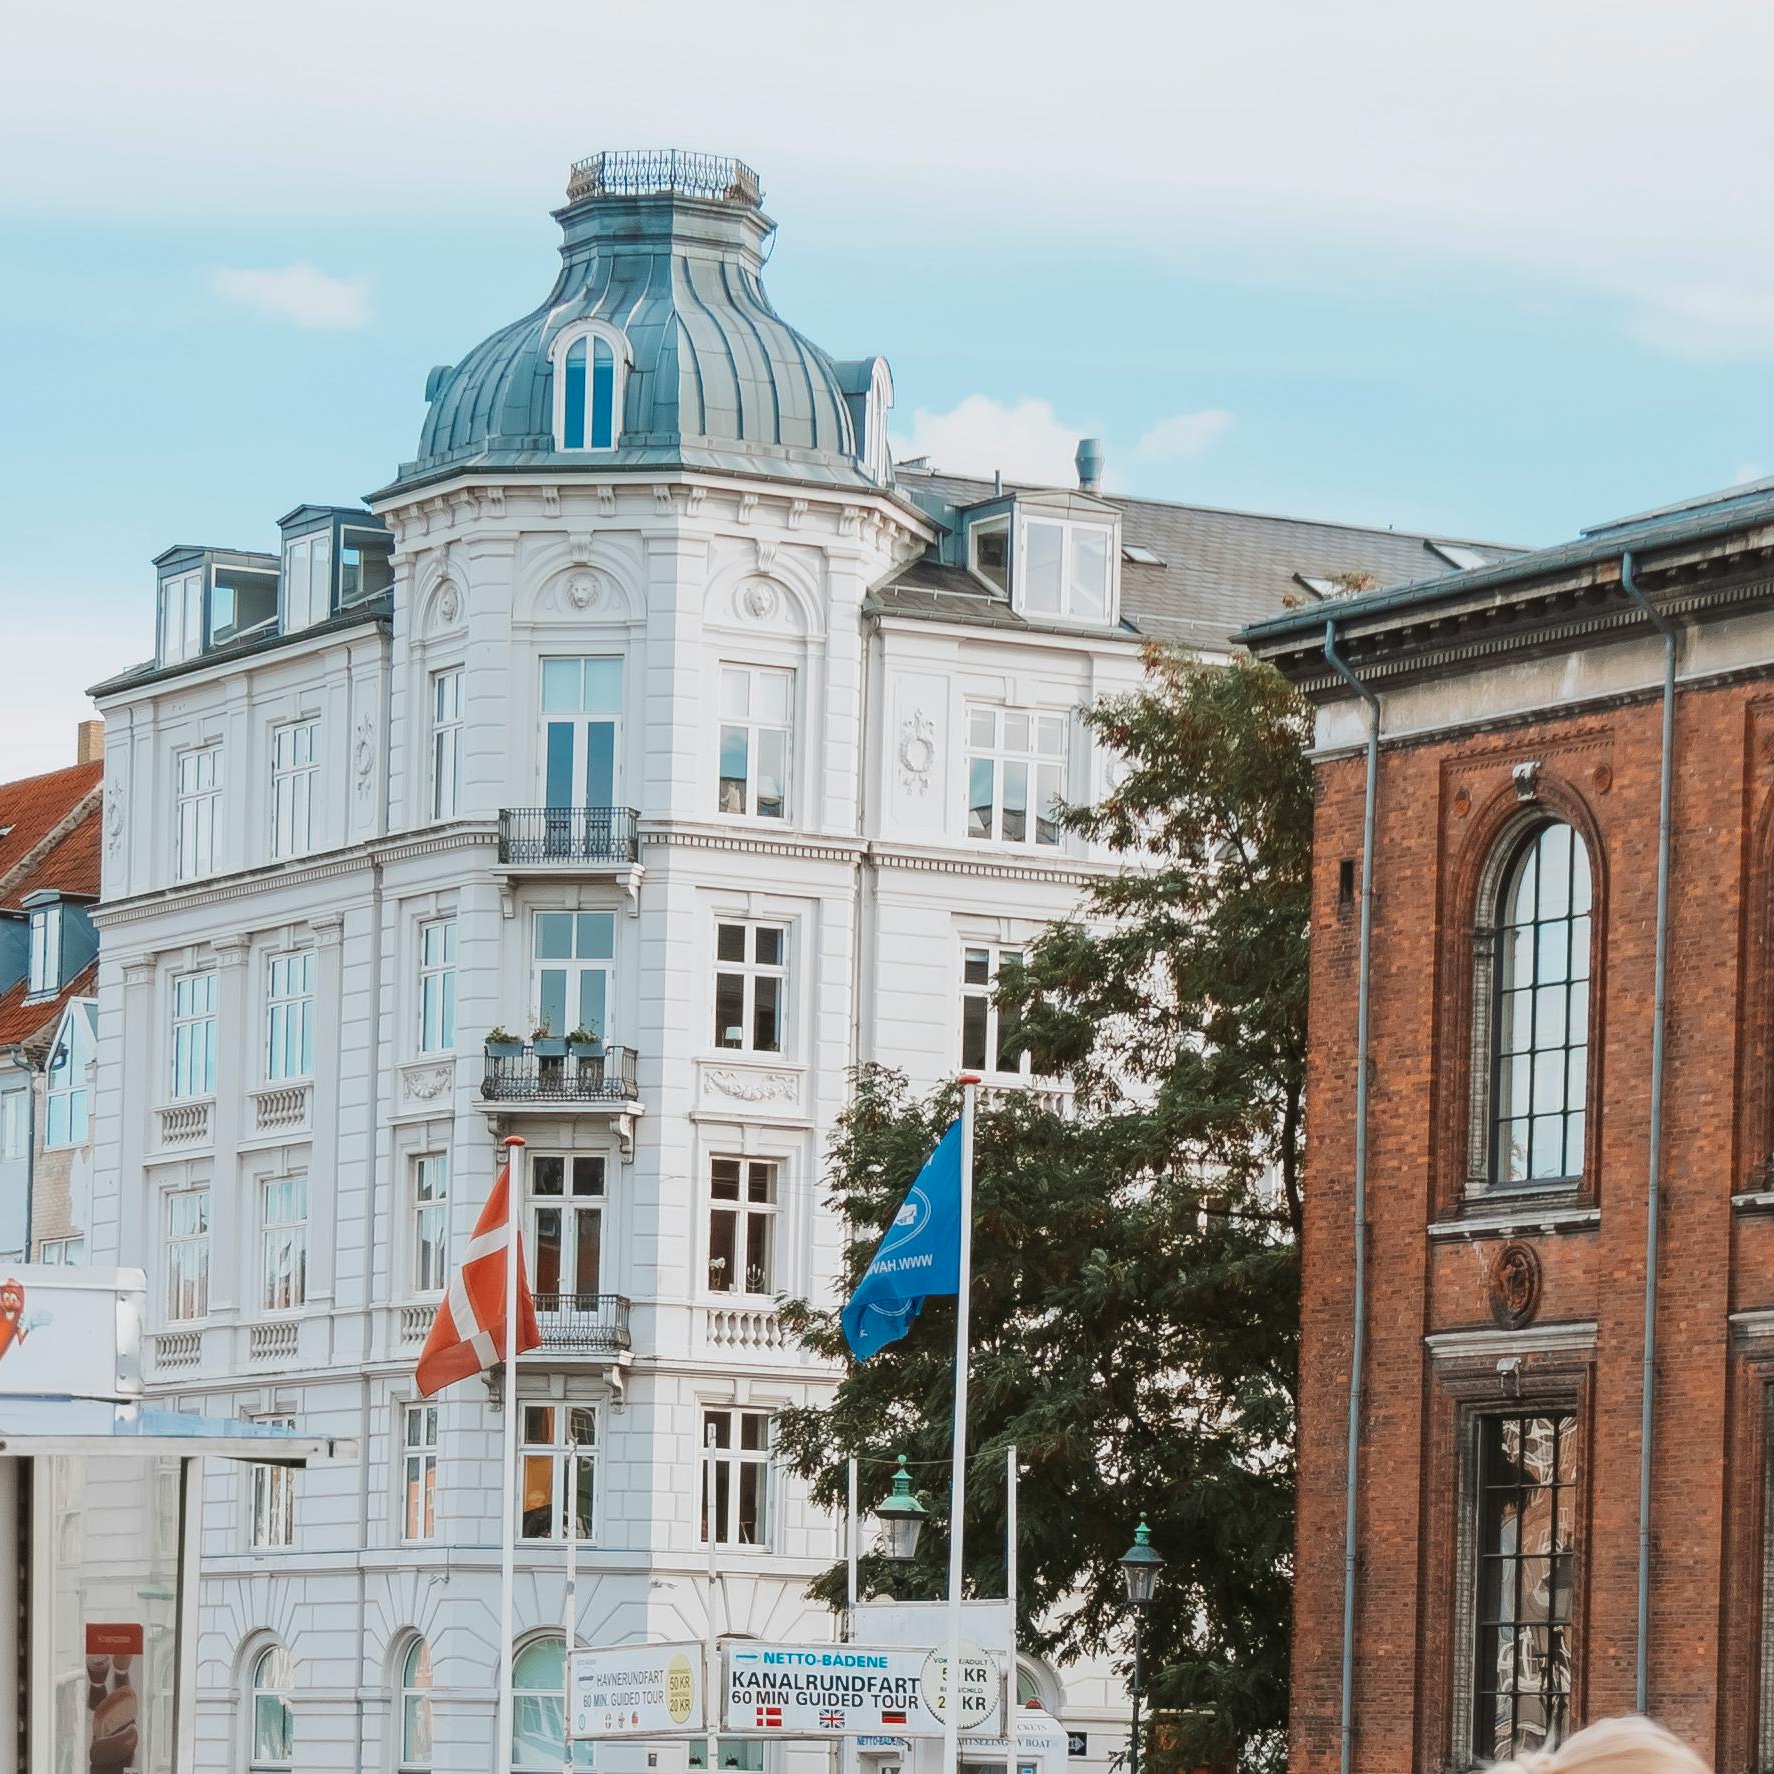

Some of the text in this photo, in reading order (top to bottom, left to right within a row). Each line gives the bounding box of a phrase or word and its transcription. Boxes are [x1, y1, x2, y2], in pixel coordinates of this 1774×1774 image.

[763, 1651, 889, 1669] NETTO-BÅDENE
[596, 1669, 664, 1688] HAVNERUNDFART
[669, 1675, 690, 1690] 50 KR
[731, 1671, 920, 1694] KANALRUNDFART
[964, 1668, 988, 1683] KR
[583, 1694, 592, 1708] 60
[610, 1692, 641, 1706] GUIDED
[643, 1690, 664, 1704] TOUR
[669, 1698, 691, 1712] 20 KR
[731, 1690, 919, 1709] 60 MIN GUIDED TOUR
[962, 1696, 987, 1711] KR
